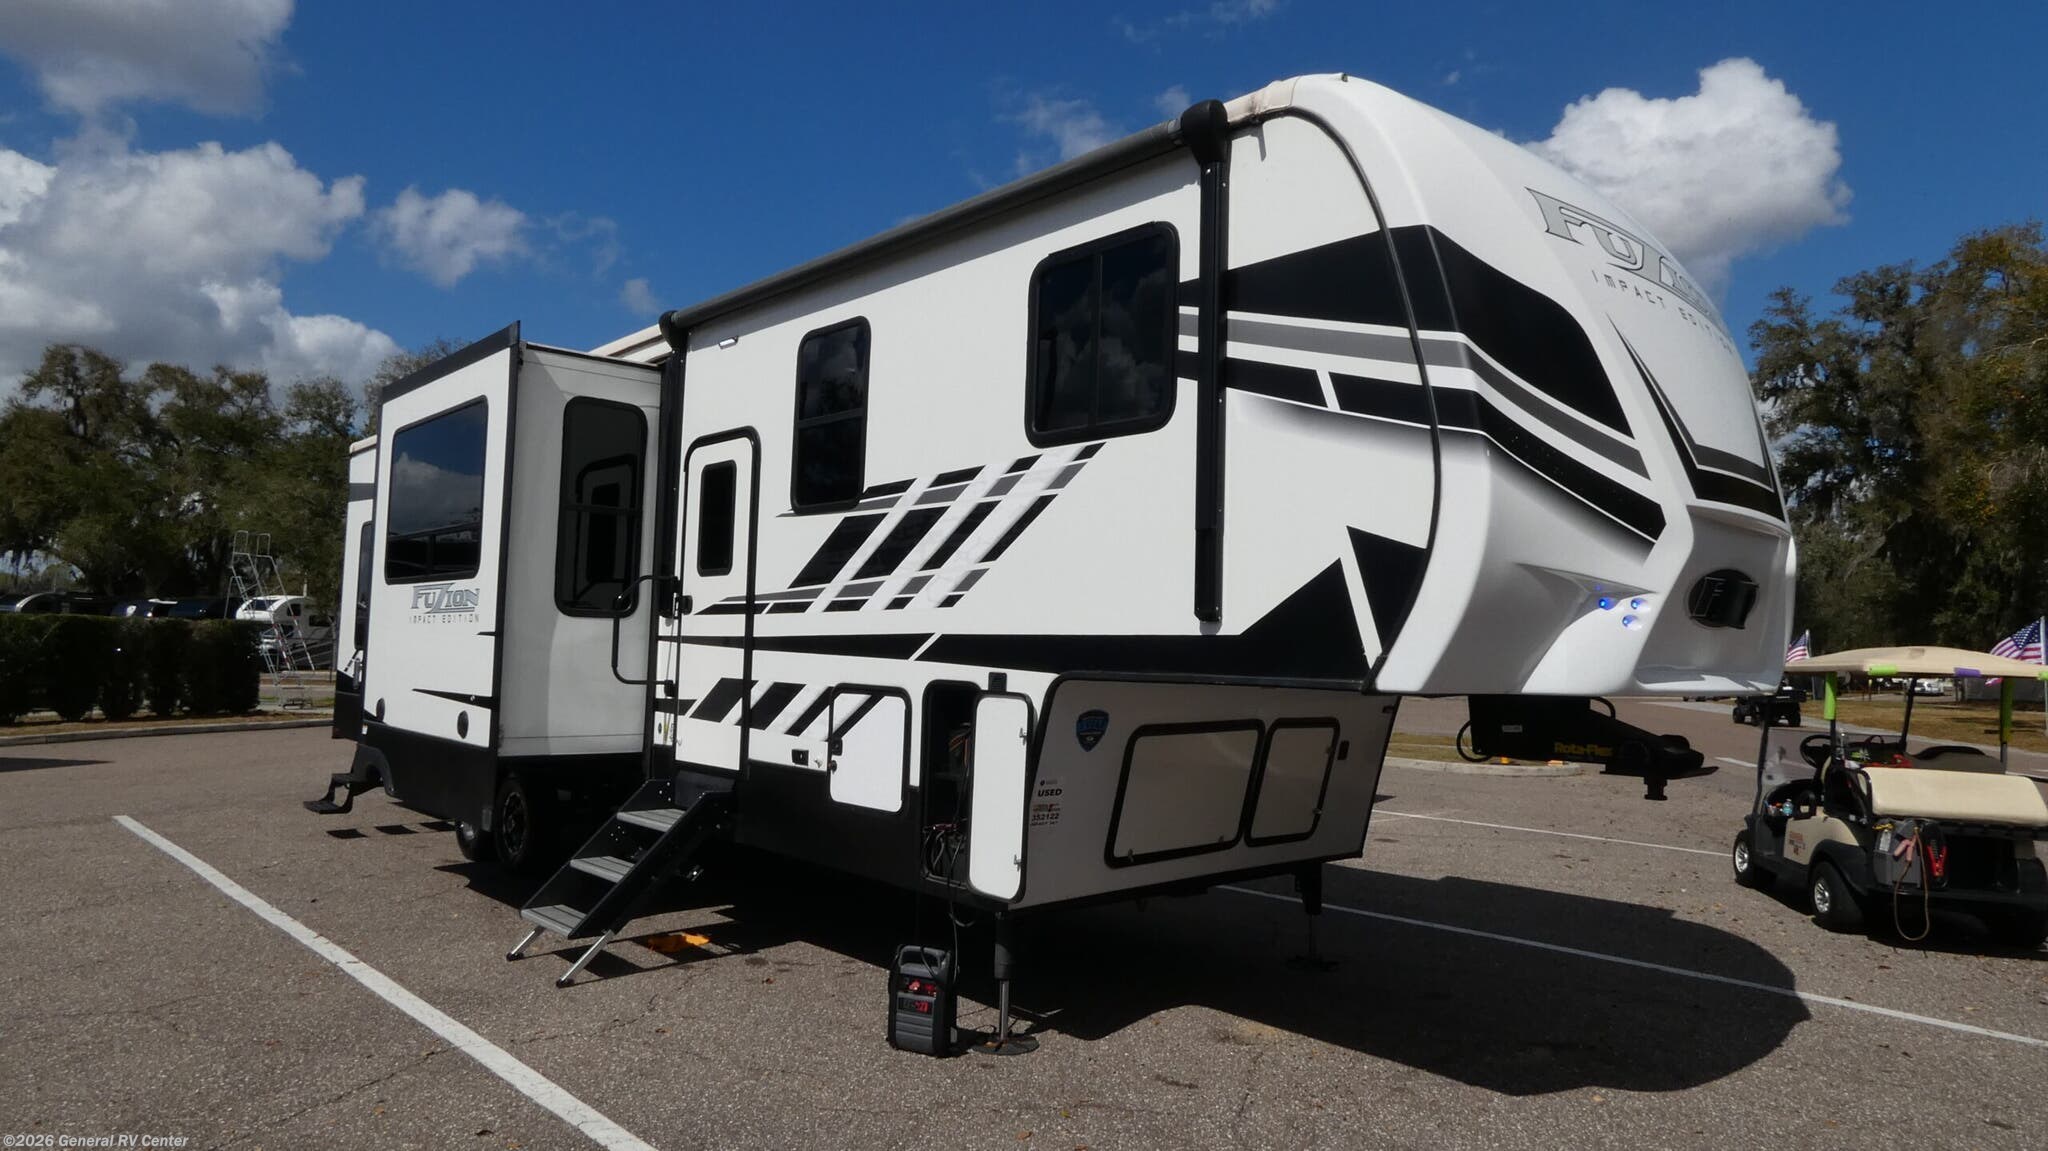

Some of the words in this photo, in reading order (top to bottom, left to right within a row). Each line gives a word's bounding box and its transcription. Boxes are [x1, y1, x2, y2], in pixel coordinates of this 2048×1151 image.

[1591, 268, 1665, 308] IMPACT
[409, 615, 436, 624] IMPACT
[441, 613, 480, 624] EDITION
[1037, 788, 1063, 797] USED
